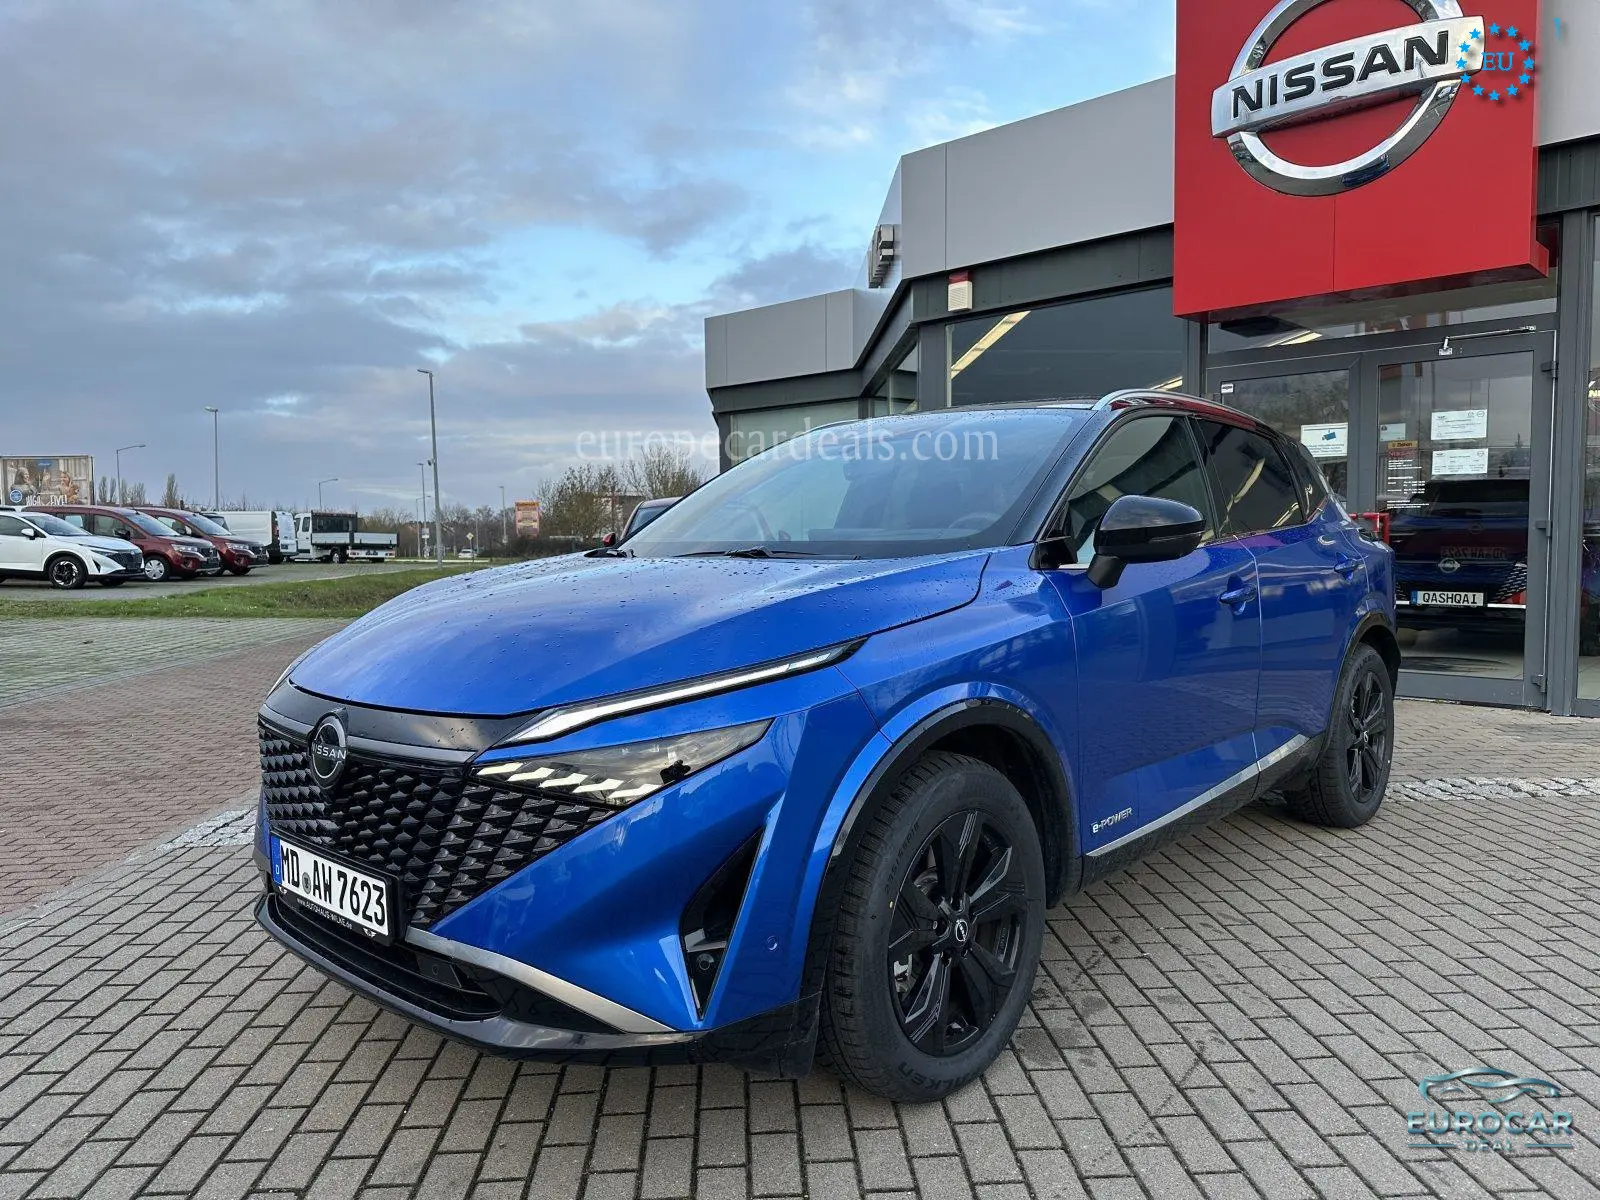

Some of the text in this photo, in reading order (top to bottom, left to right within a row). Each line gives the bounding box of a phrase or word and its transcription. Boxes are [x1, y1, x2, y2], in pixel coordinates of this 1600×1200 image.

[1231, 30, 1450, 118] NISSAN
[1422, 592, 1477, 604] QASHQAI
[312, 741, 346, 760] NISSAN
[1091, 807, 1133, 834] e-POWER
[275, 864, 280, 875] D
[281, 845, 386, 927] MD AW 7623
